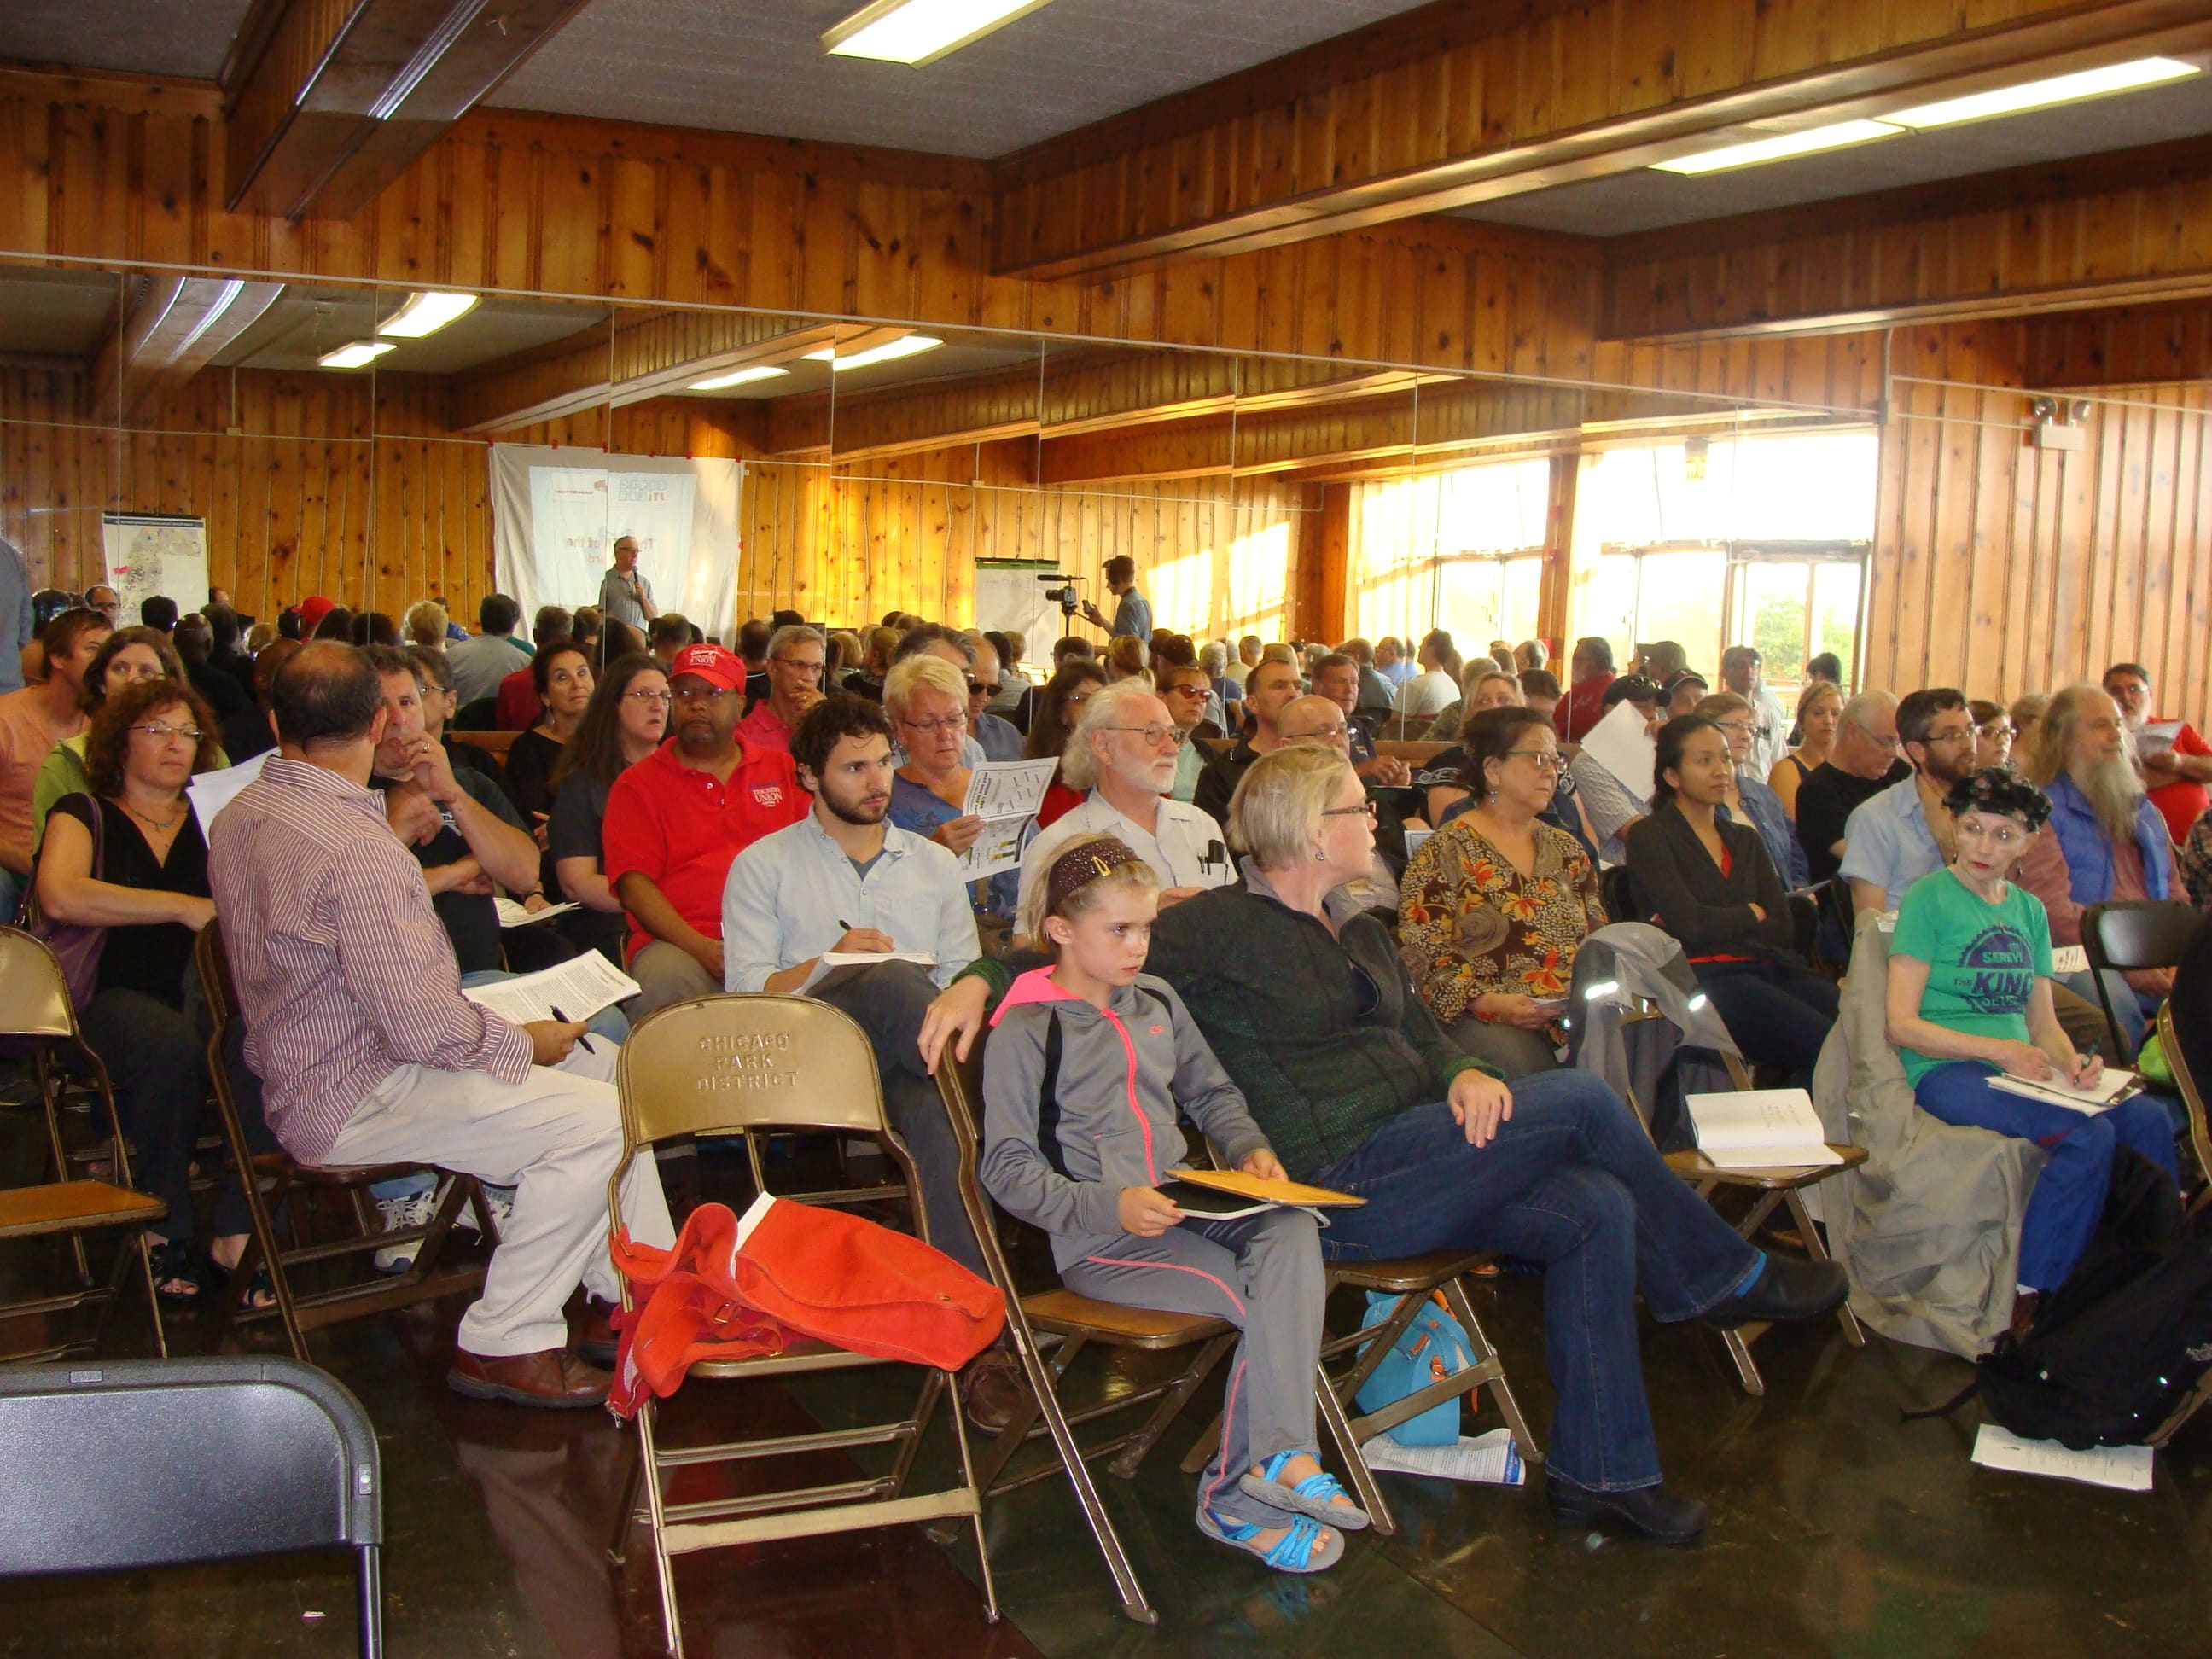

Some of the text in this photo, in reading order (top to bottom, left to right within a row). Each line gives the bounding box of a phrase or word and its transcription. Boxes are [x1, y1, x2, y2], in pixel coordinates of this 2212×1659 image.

[754, 792, 783, 804] UNION
[699, 1033, 789, 1051] CHICAGO
[716, 1054, 773, 1071] PARK
[696, 1071, 800, 1091] DISTRICT
